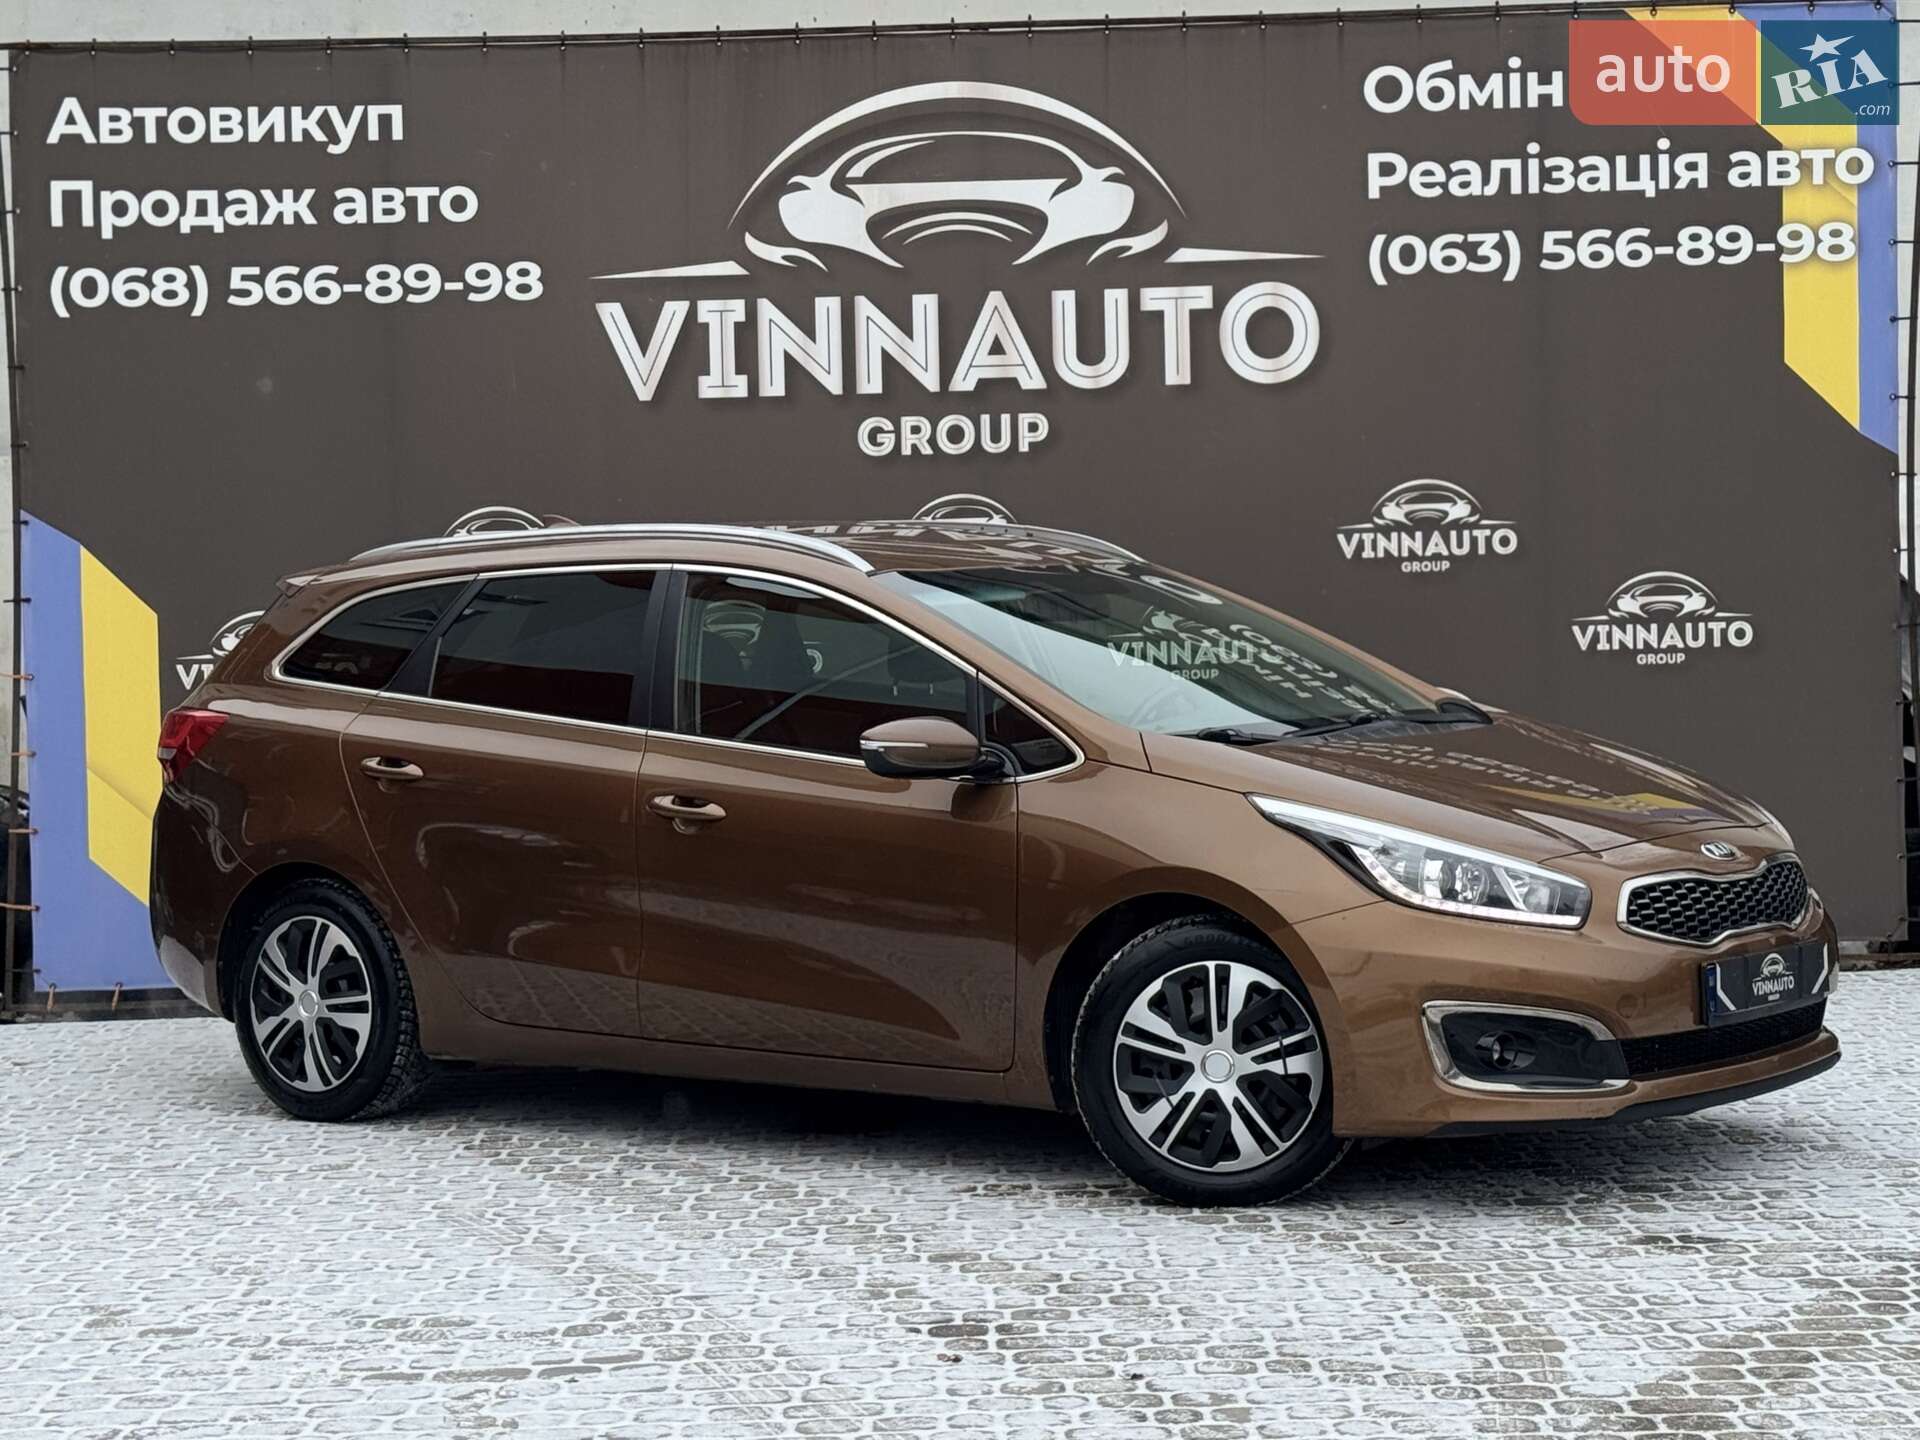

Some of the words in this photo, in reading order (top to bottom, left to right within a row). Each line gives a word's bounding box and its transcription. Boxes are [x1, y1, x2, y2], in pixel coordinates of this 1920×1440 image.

[1364, 56, 1563, 113] Обмін
[46, 97, 404, 154] Автовикуп
[1367, 137, 1708, 199] Реалізація
[1728, 147, 1874, 188] авто
[50, 180, 318, 239] Продаж
[333, 185, 479, 225] авто
[1368, 229, 1521, 286] (063)
[1540, 222, 1857, 271] 566-89-98
[50, 264, 209, 317] (068)
[227, 261, 544, 306] 566-89-98
[595, 281, 1320, 402] VINNAUTO
[857, 412, 1049, 457] GROUP
[1337, 528, 1518, 559] VINNAUTO
[1401, 560, 1450, 573] GROUP
[1572, 620, 1754, 651] VINNAUTO
[1636, 653, 1686, 665] GROUP
